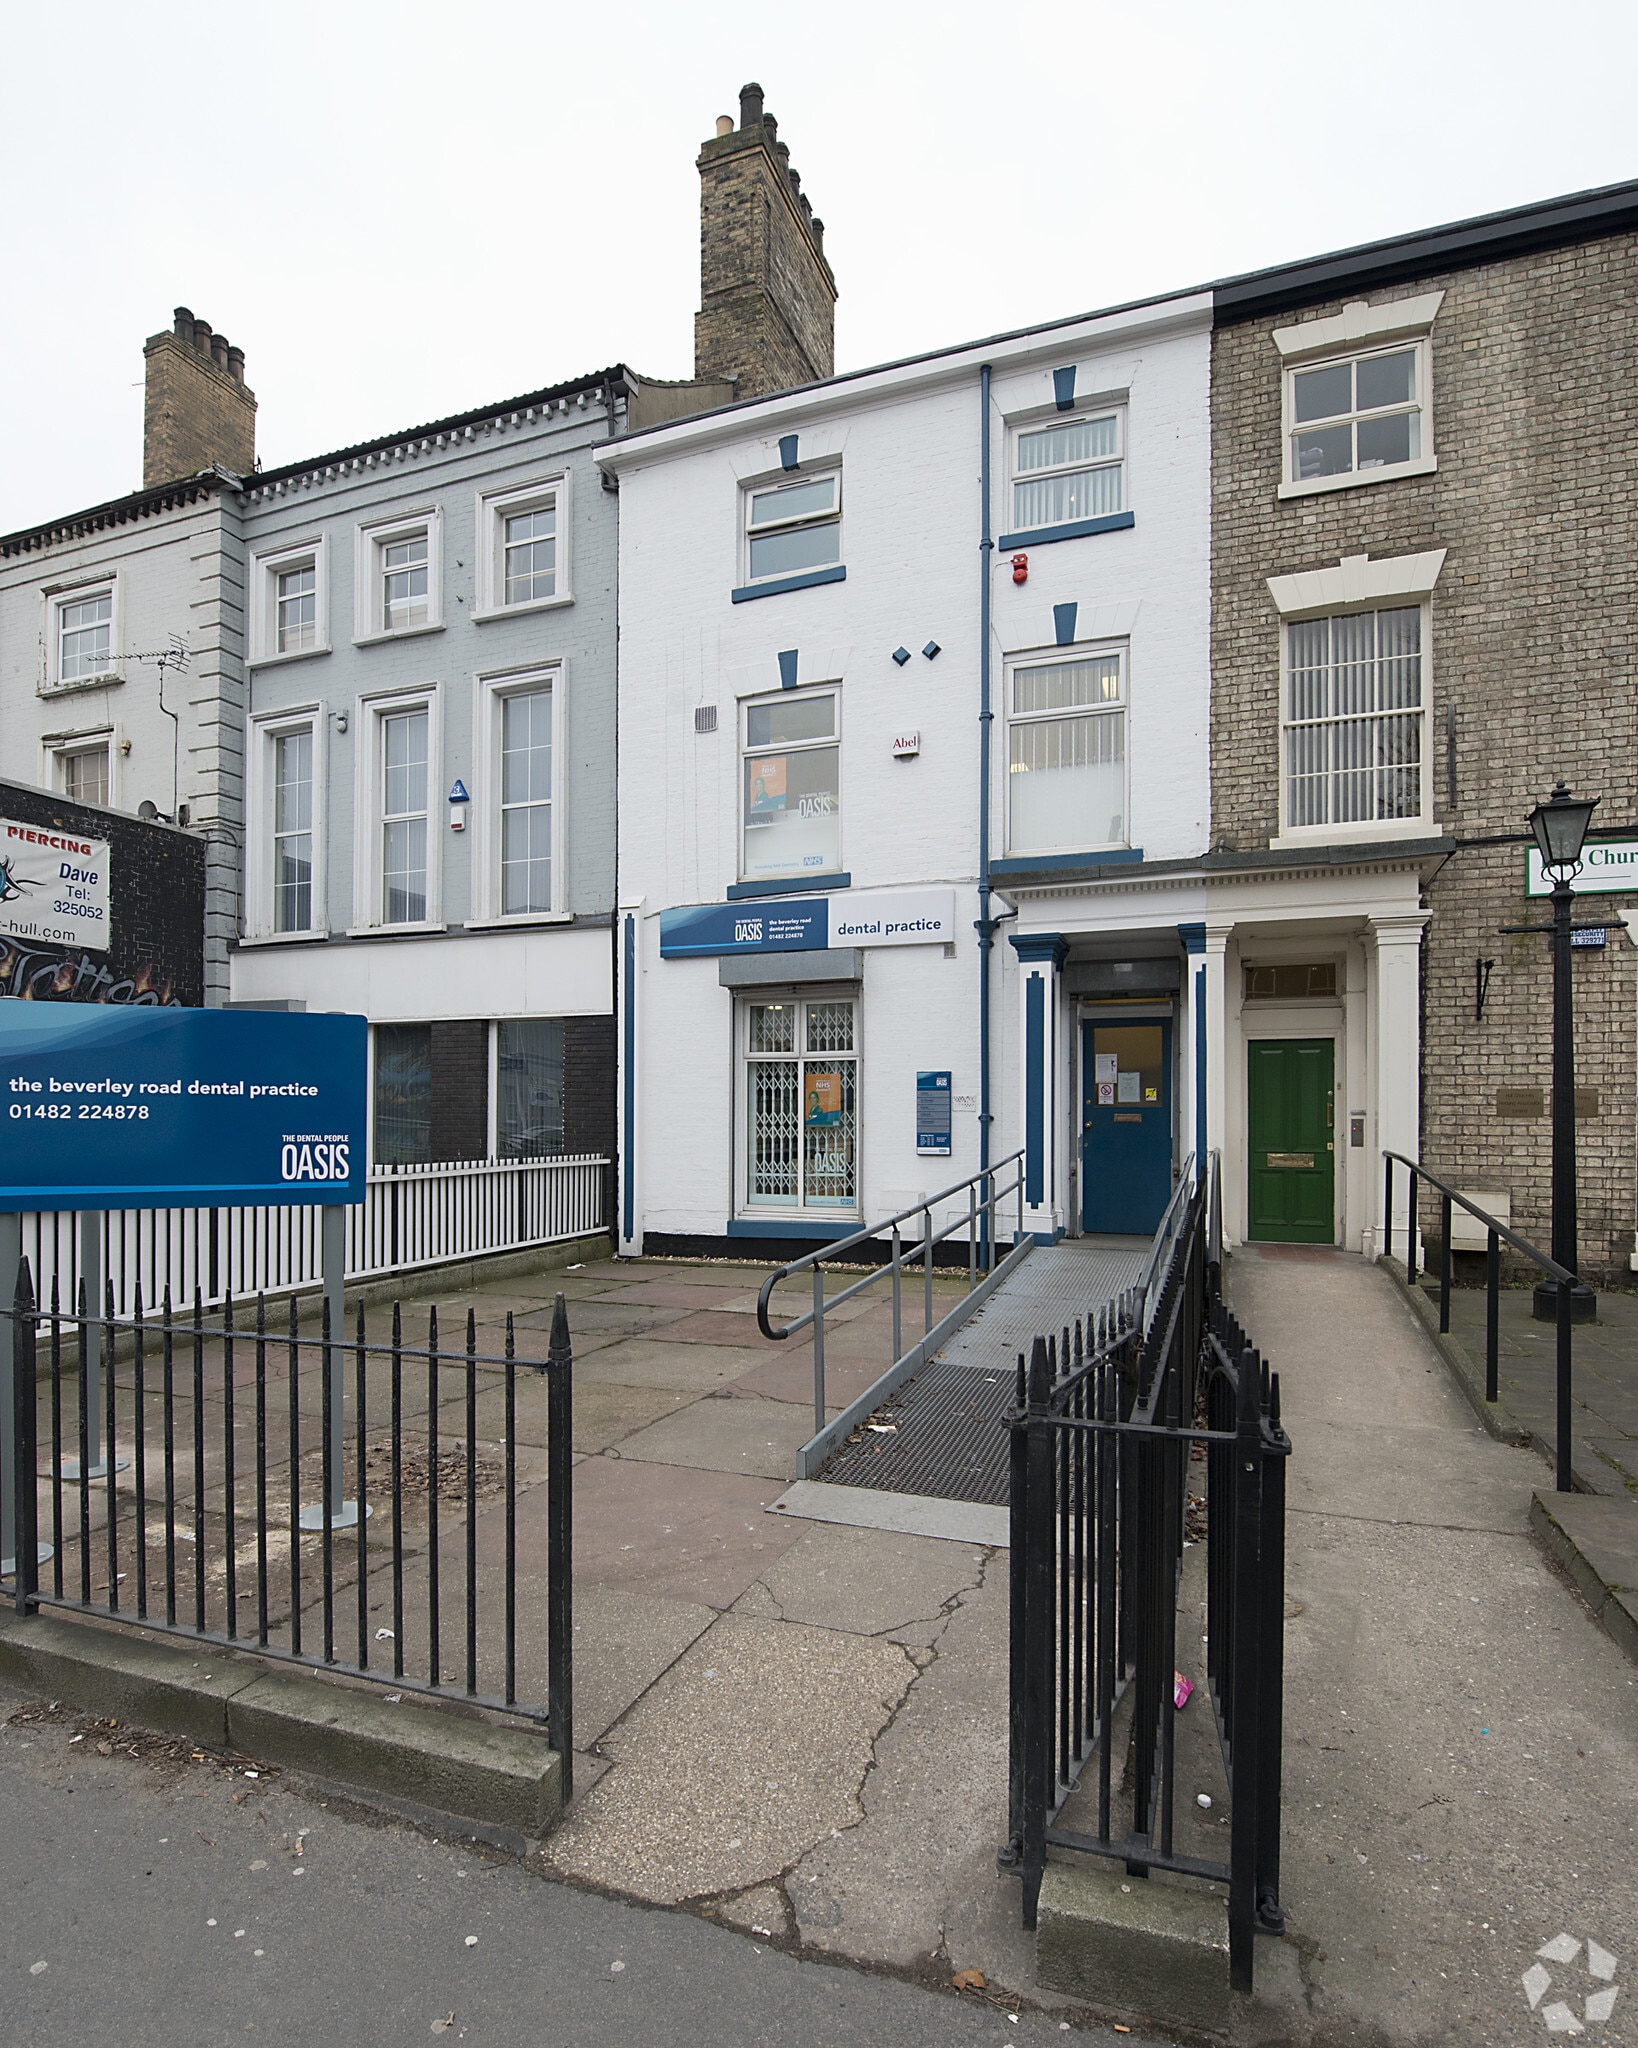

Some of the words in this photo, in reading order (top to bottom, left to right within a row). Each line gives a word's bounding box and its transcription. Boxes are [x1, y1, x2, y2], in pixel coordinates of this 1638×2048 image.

[893, 736, 916, 749] Abel
[799, 797, 830, 818] OASIS
[7, 826, 91, 856] PIERCING
[803, 856, 823, 866] NHS
[59, 863, 98, 884] Dave
[65, 885, 90, 900] Tel:
[53, 900, 103, 920] 325052
[0, 920, 75, 941] -hull.com
[735, 923, 762, 941] OASIS
[838, 920, 880, 935] dental
[885, 918, 941, 936] practice
[9, 1077, 42, 1092] the
[49, 1077, 134, 1097] beverley
[139, 1079, 182, 1094] road
[187, 1080, 244, 1095] dental
[250, 1082, 319, 1099] practice
[9, 1104, 71, 1119] 01482
[78, 1105, 149, 1119] 224878
[282, 1144, 349, 1180] OASIS
[814, 1152, 846, 1173] OASIS
